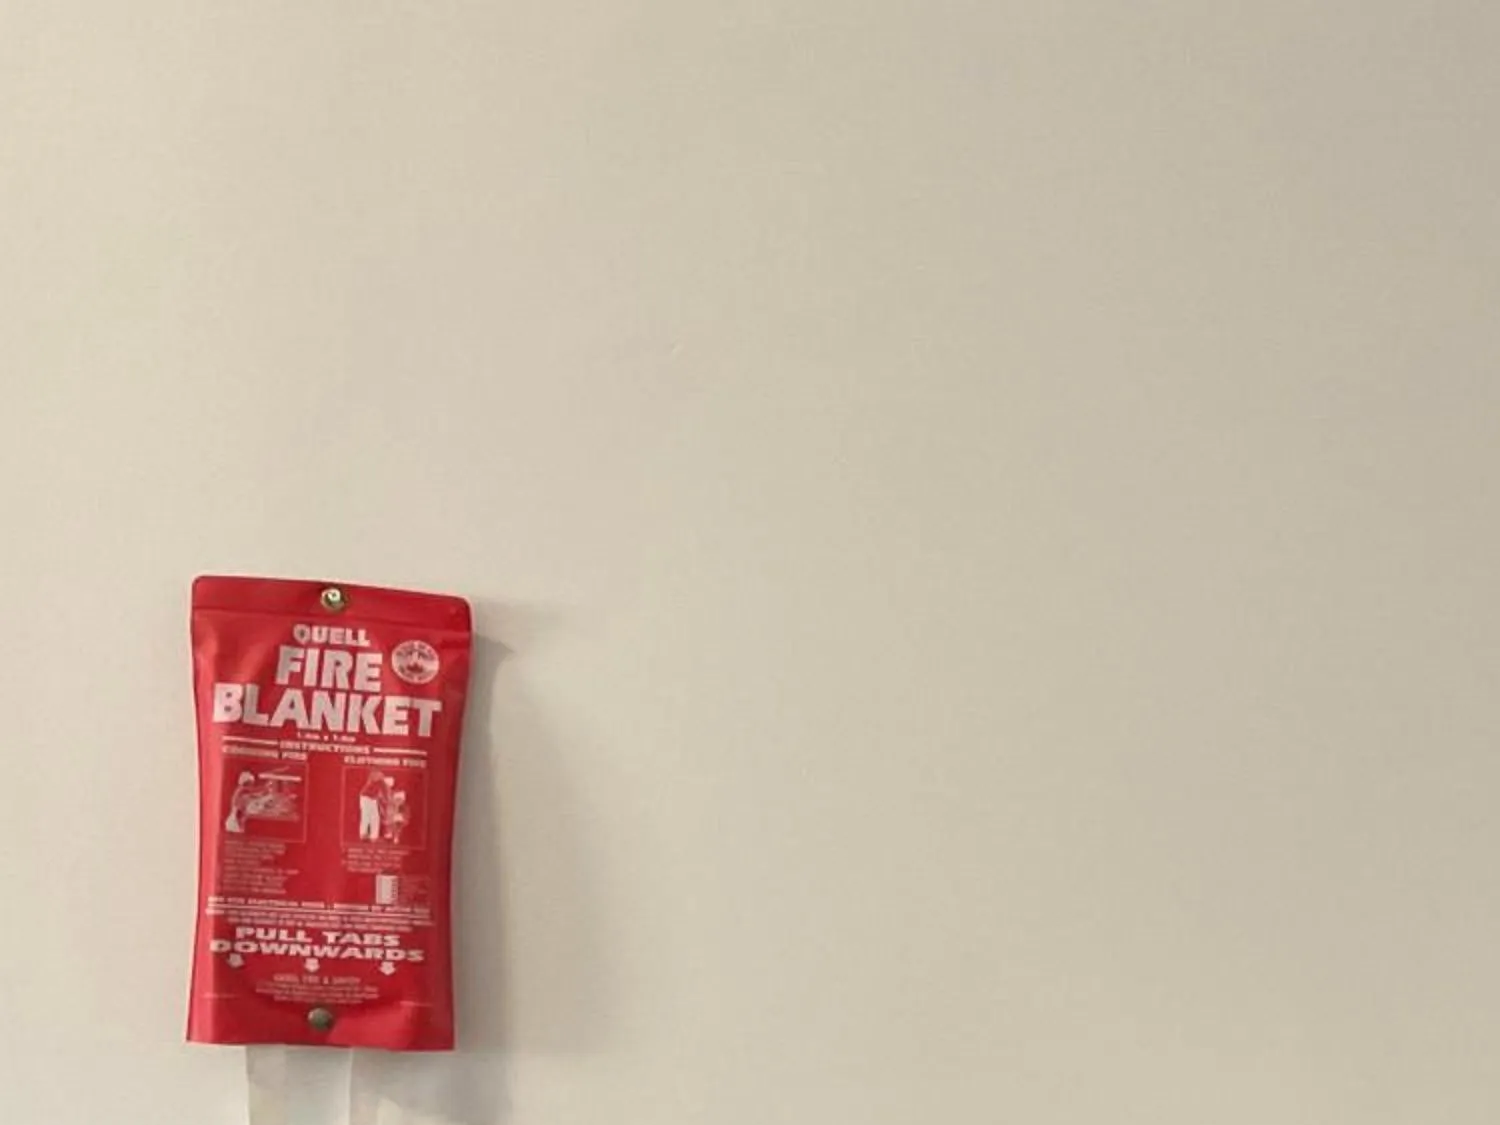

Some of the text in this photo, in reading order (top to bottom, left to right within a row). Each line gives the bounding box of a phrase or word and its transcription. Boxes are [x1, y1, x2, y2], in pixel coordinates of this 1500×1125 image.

[293, 624, 371, 648] QUELL
[275, 645, 383, 693] FIRE
[212, 682, 442, 737] BLANKET
[235, 926, 401, 947] PULL TABS
[209, 938, 424, 962] DOWNWARDS
